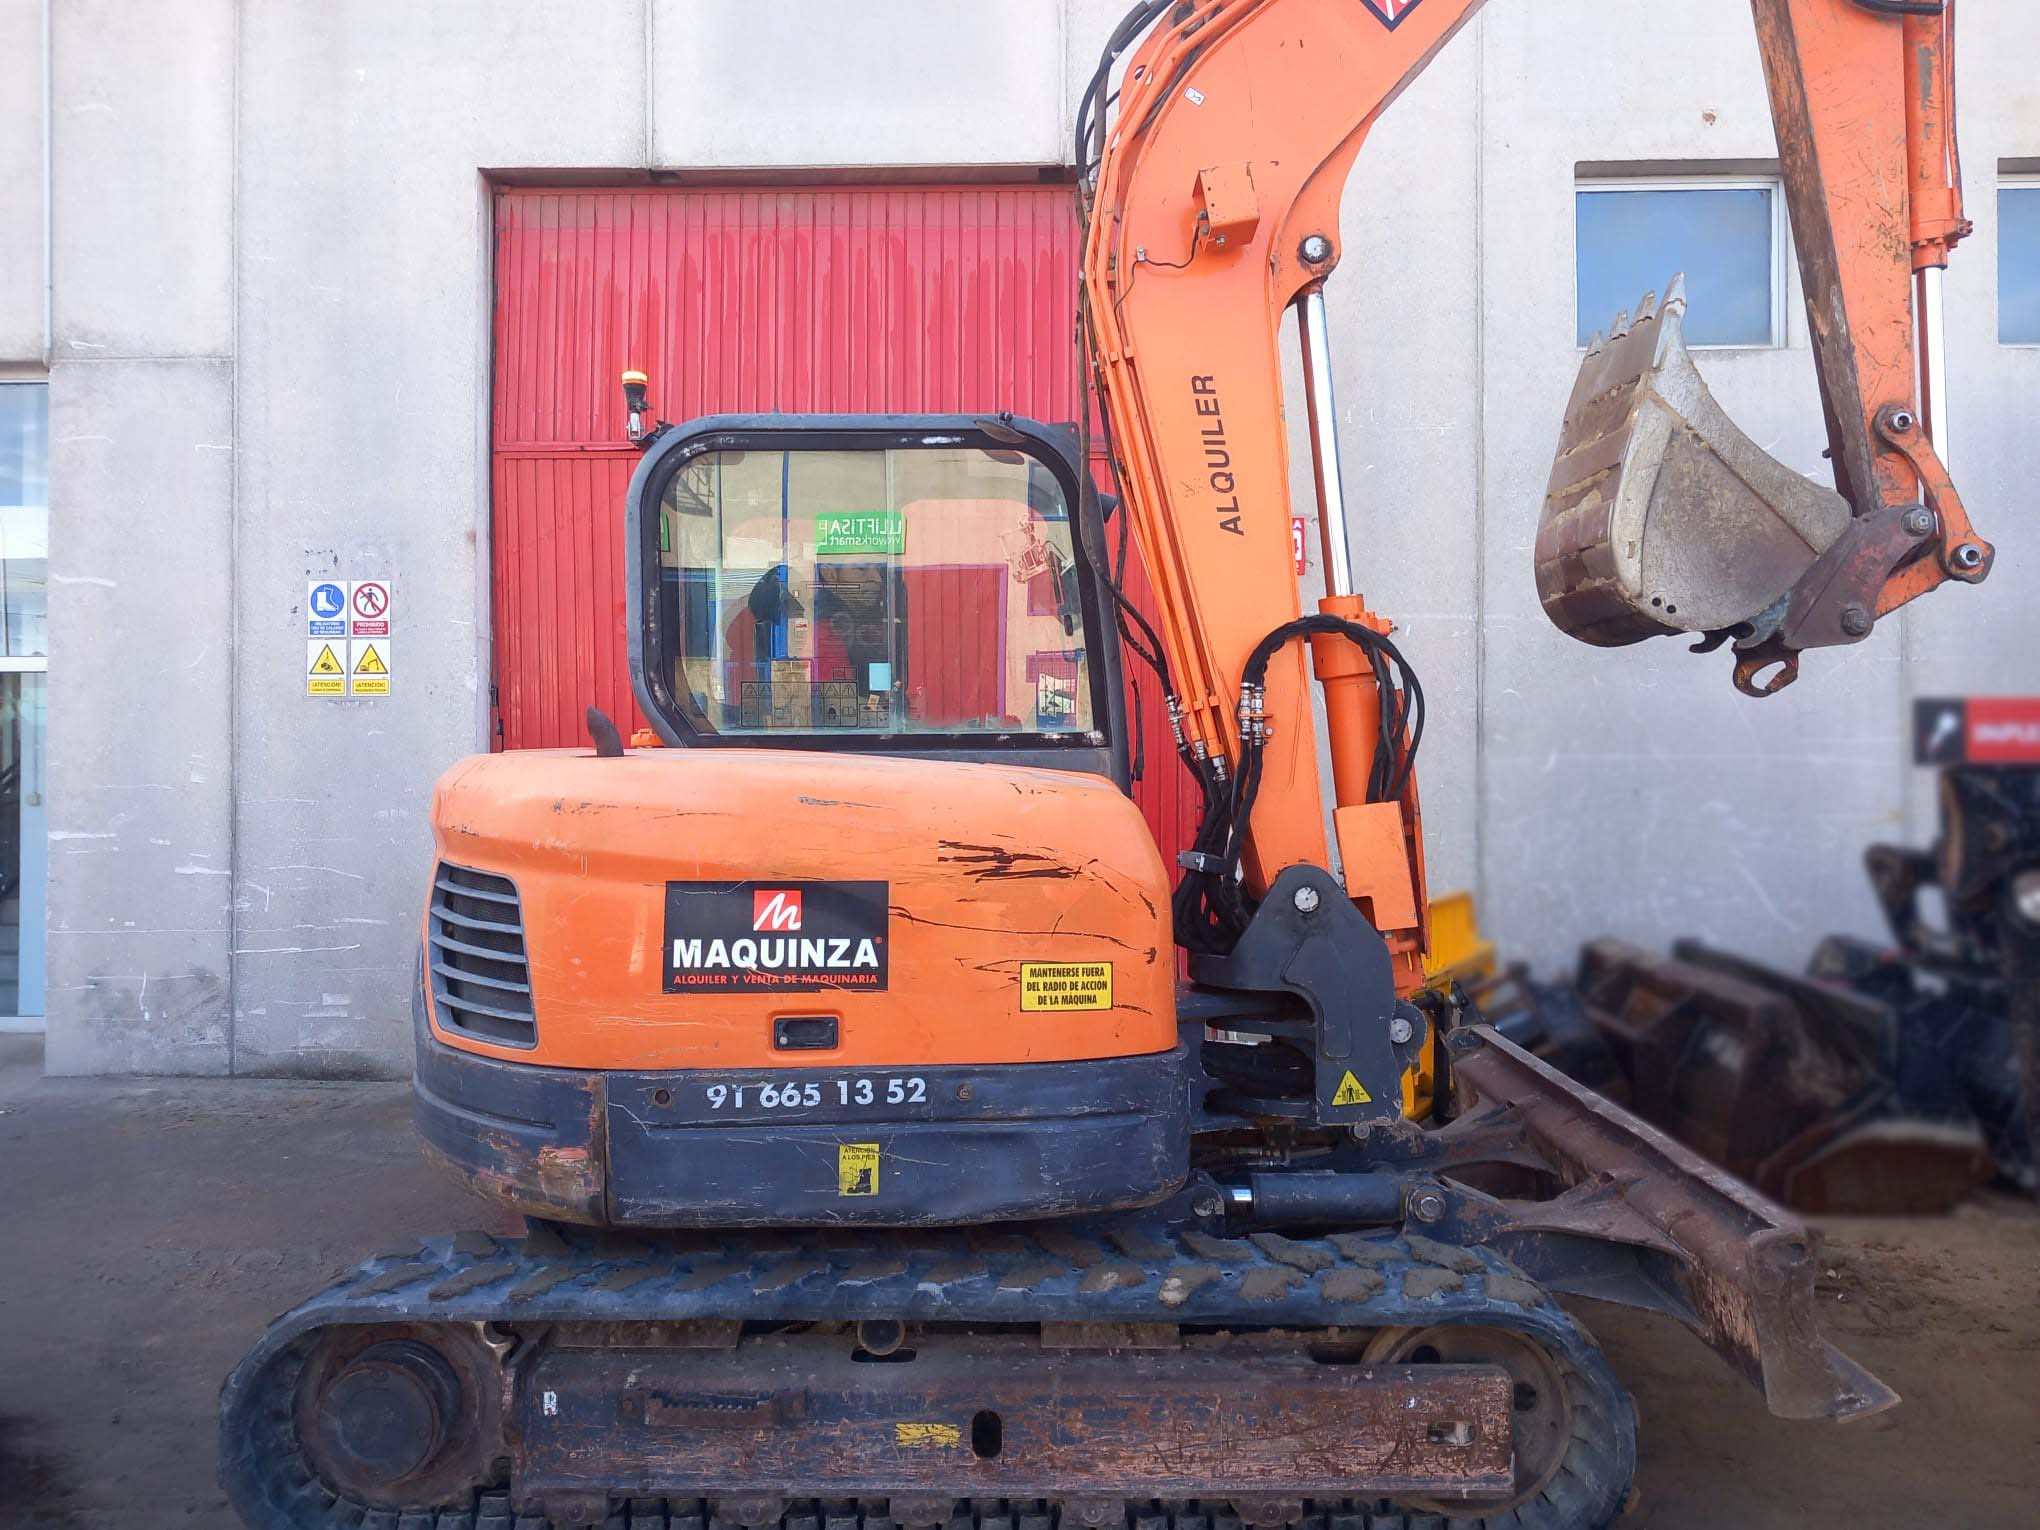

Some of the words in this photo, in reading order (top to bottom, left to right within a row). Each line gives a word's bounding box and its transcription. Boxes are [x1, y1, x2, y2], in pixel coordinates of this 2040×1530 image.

[1191, 375, 1244, 537] ALQUILER
[672, 938, 880, 970] MAQUINZA
[1030, 968, 1079, 977] MANTENERSE
[1082, 967, 1104, 977] FUERA
[673, 975, 727, 985] ALQUILER
[732, 975, 739, 984] Y
[744, 975, 779, 984] VENTA
[783, 974, 797, 984] DE
[801, 974, 878, 984] MAQUINARIA
[1026, 981, 1040, 991] DEL
[1042, 981, 1067, 991] RADIO
[1069, 981, 1079, 990] DE
[1038, 995, 1047, 1005] DE
[1049, 995, 1059, 1005] LA
[706, 1084, 743, 1109] 91
[759, 1082, 821, 1108] 665
[836, 1079, 874, 1105] 13
[886, 1078, 927, 1104] 52
